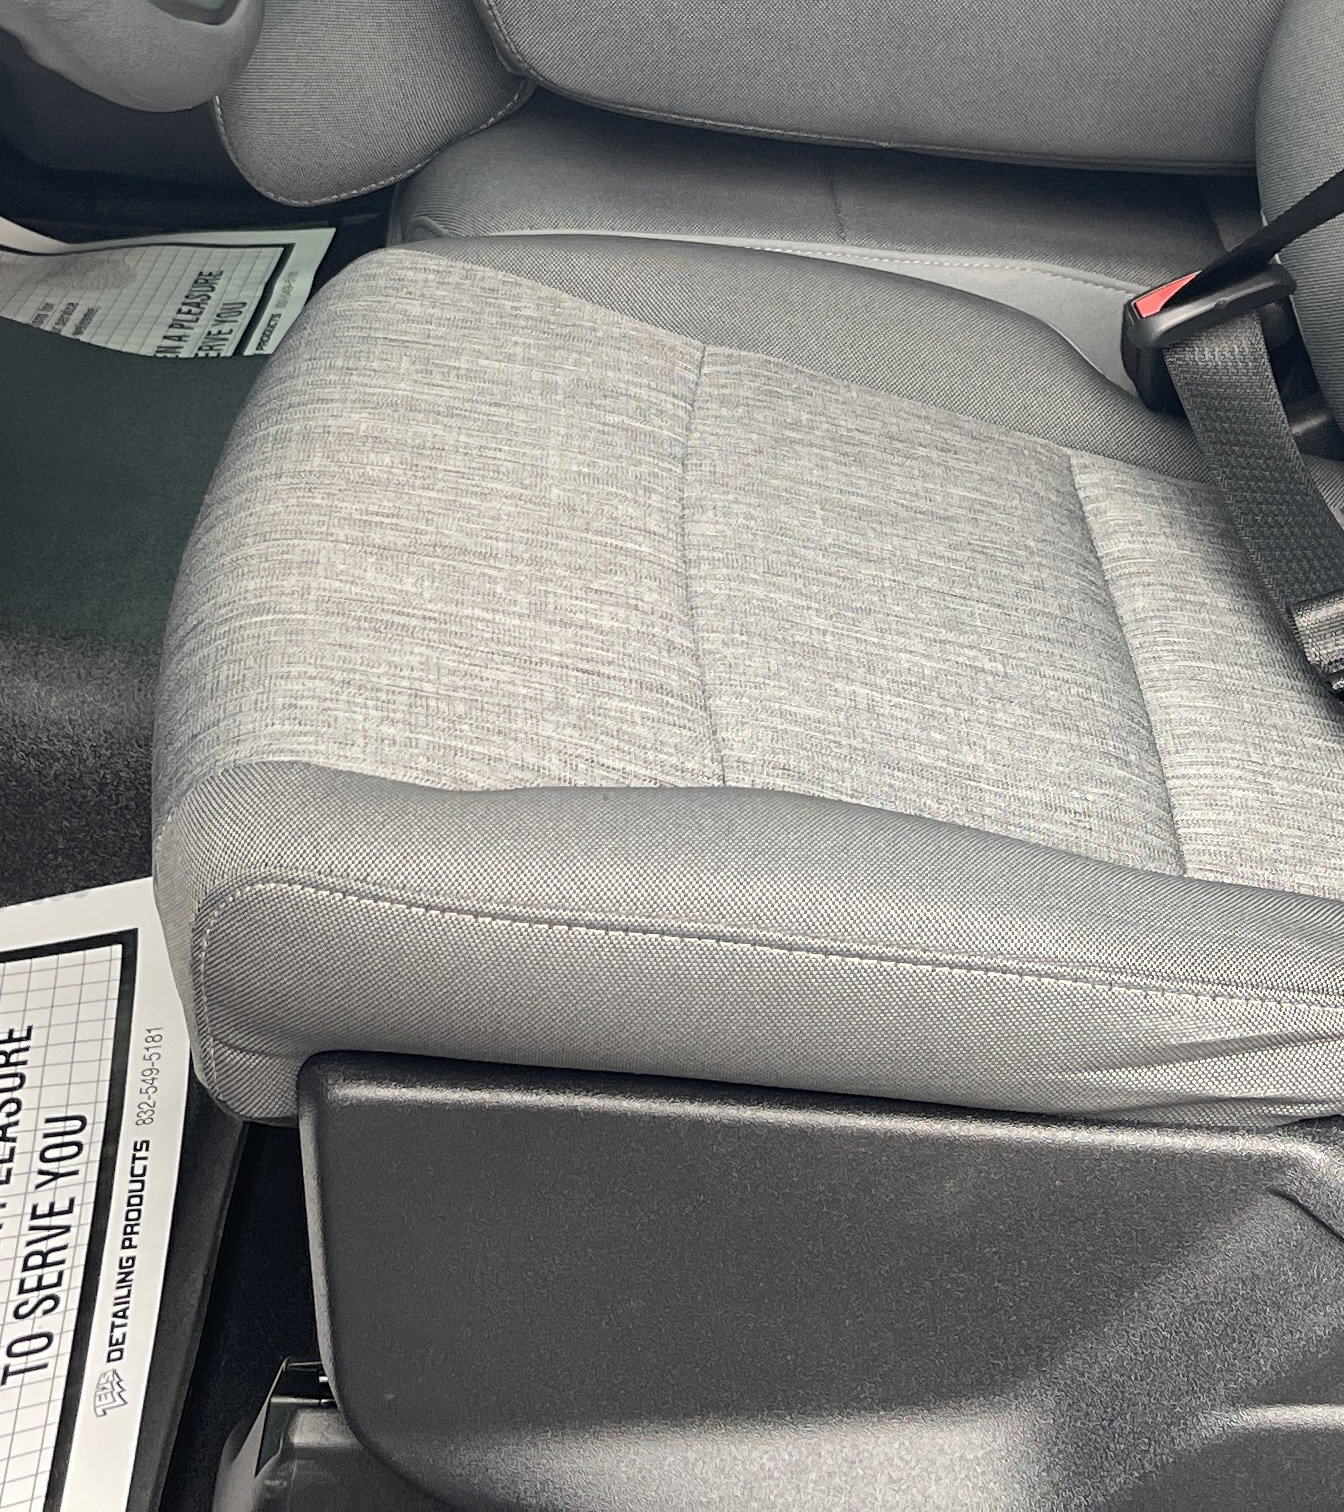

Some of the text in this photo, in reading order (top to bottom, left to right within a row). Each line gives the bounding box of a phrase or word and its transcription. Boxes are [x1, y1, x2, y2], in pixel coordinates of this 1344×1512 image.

[162, 335, 191, 343] A
[168, 270, 224, 330] PLEASURE
[211, 301, 247, 327] YOU
[135, 1026, 164, 1126] 832-549-5181
[121, 1139, 150, 1249] PRODUCTS
[0, 1114, 88, 1387] TO SERVE YOU
[106, 1255, 136, 1363] DETAILING
